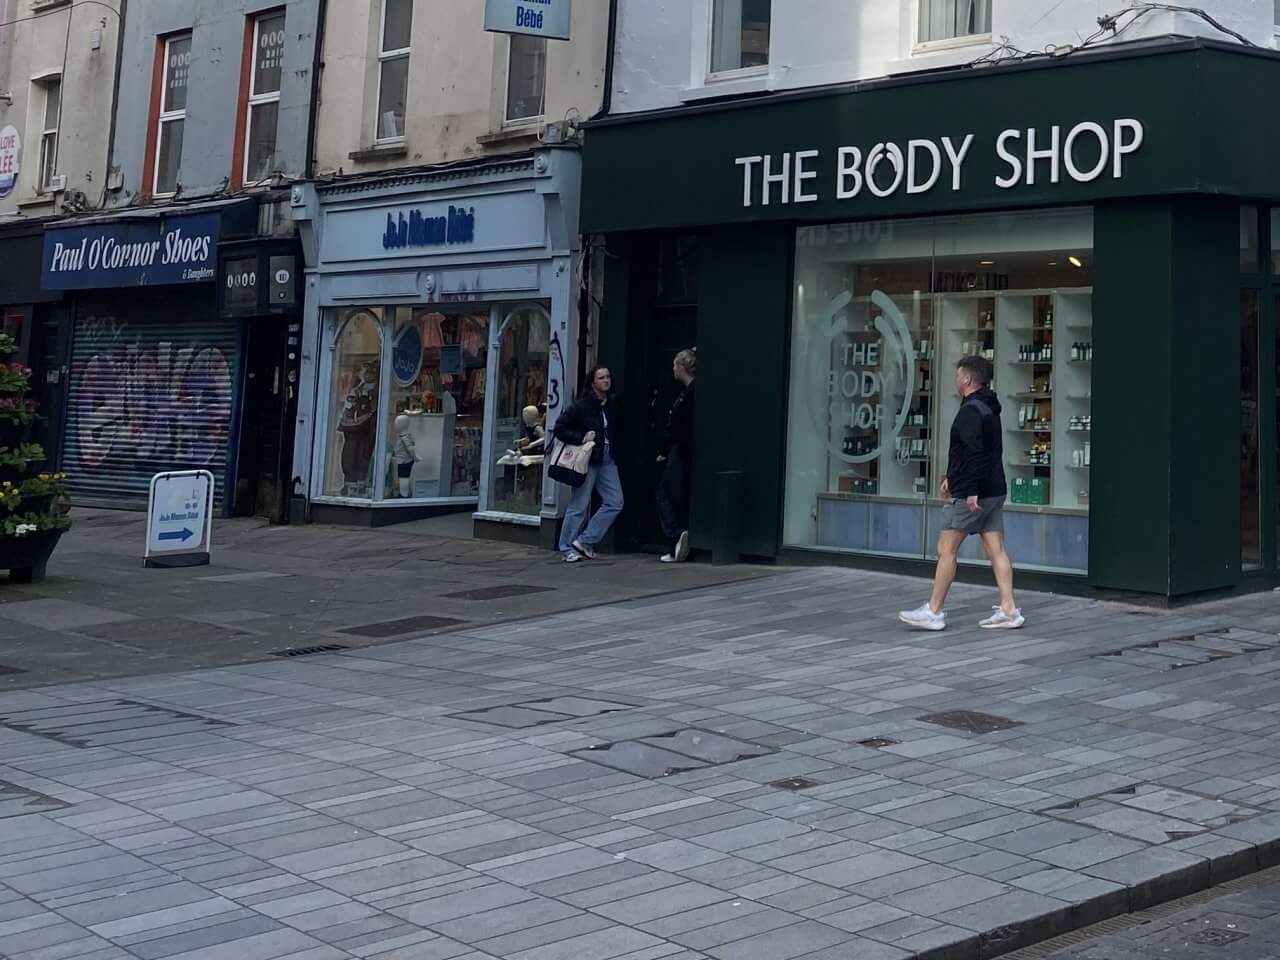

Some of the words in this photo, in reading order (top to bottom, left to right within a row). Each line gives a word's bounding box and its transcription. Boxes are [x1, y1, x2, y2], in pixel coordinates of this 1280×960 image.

[516, 6, 544, 29] Bébé
[735, 149, 819, 207] THE
[836, 134, 975, 199] BODY
[995, 118, 1144, 189] SHOP
[50, 238, 88, 272] Paul
[88, 236, 160, 270] O'Connor
[162, 228, 211, 265] Shoes
[841, 343, 880, 366] THE
[827, 370, 894, 400] BODY
